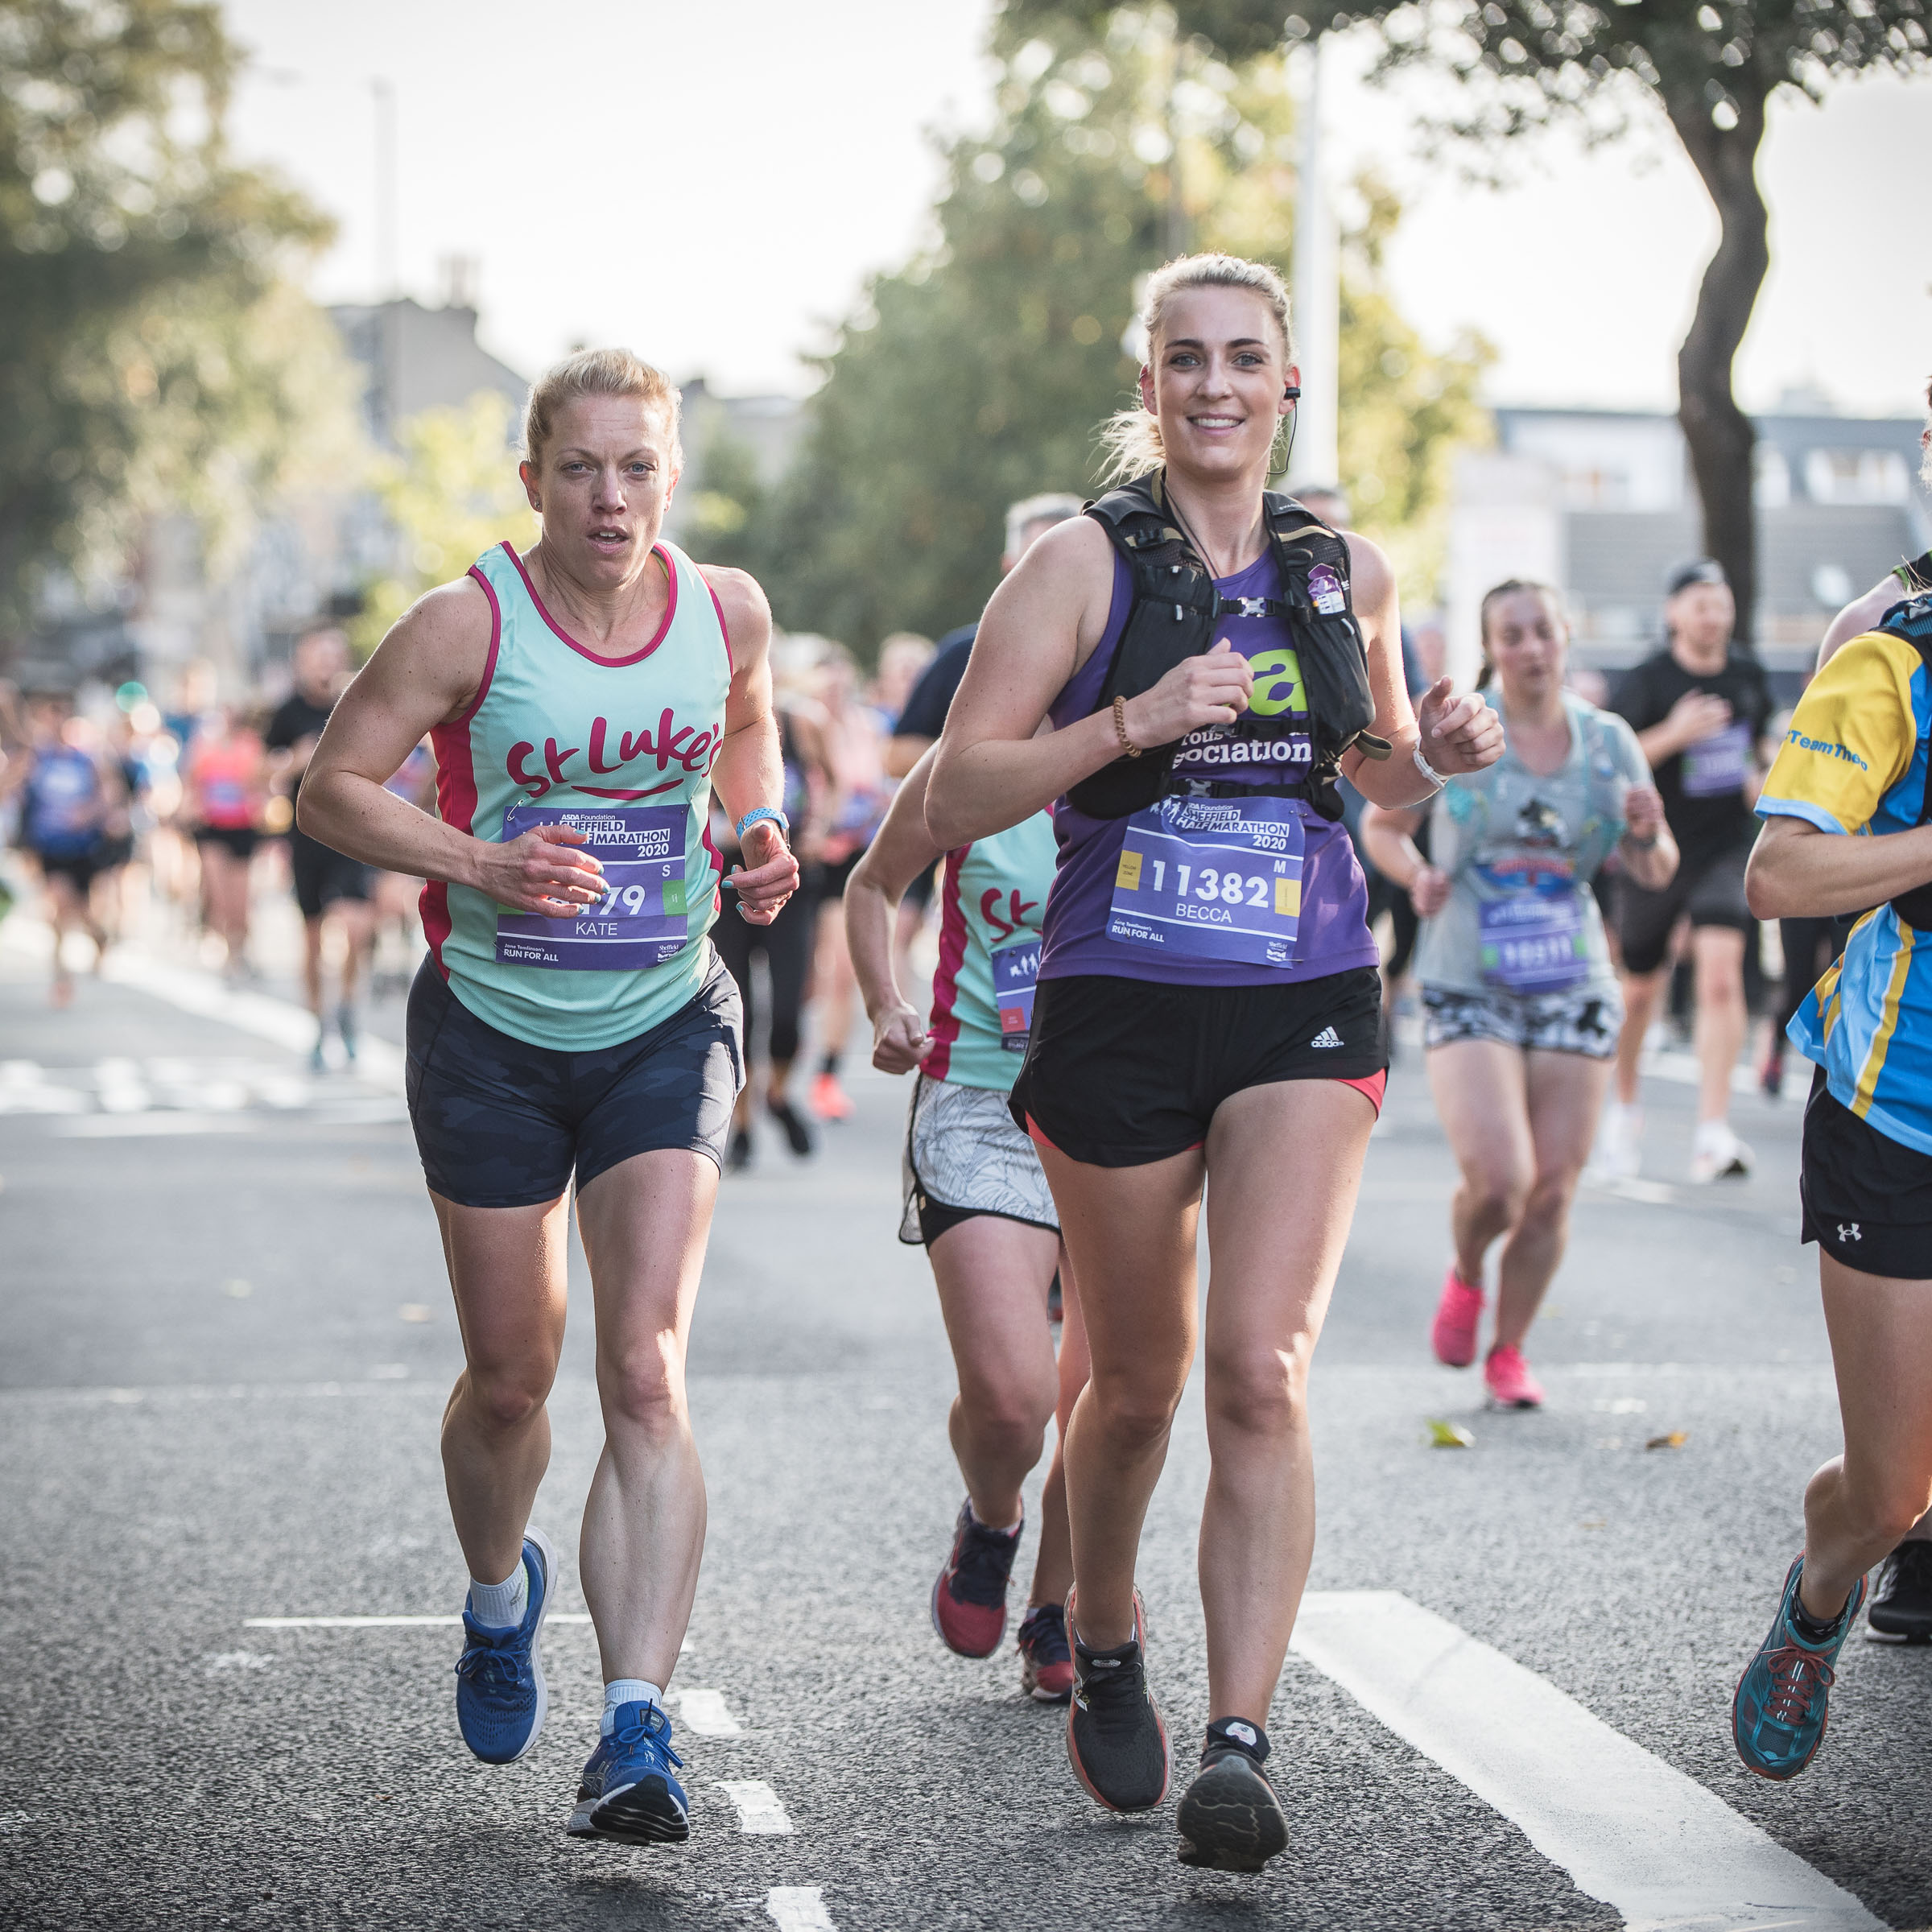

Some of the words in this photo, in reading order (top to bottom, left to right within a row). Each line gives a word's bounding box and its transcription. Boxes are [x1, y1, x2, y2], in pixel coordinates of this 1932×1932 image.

[506, 737, 580, 798] St
[1183, 807, 1239, 821] SHEFFIELD
[1176, 815, 1209, 830] HALF
[1209, 821, 1289, 836] MARATHON
[595, 829, 670, 844] MARATHON
[1253, 834, 1287, 851] 2020
[638, 844, 670, 857] 2020
[662, 865, 671, 877] S
[1273, 859, 1287, 874] M
[1153, 860, 1269, 909] 11382
[980, 887, 1039, 943] St
[1174, 903, 1233, 924] BECCA
[576, 922, 618, 936] KATE
[1112, 925, 1131, 935] RUN
[1131, 929, 1148, 939] FOR
[1149, 933, 1165, 943] ALL
[504, 948, 522, 958] RUN
[524, 952, 542, 960] FOR
[543, 954, 559, 962] ALL
[518, 944, 545, 952] Tomlinson's
